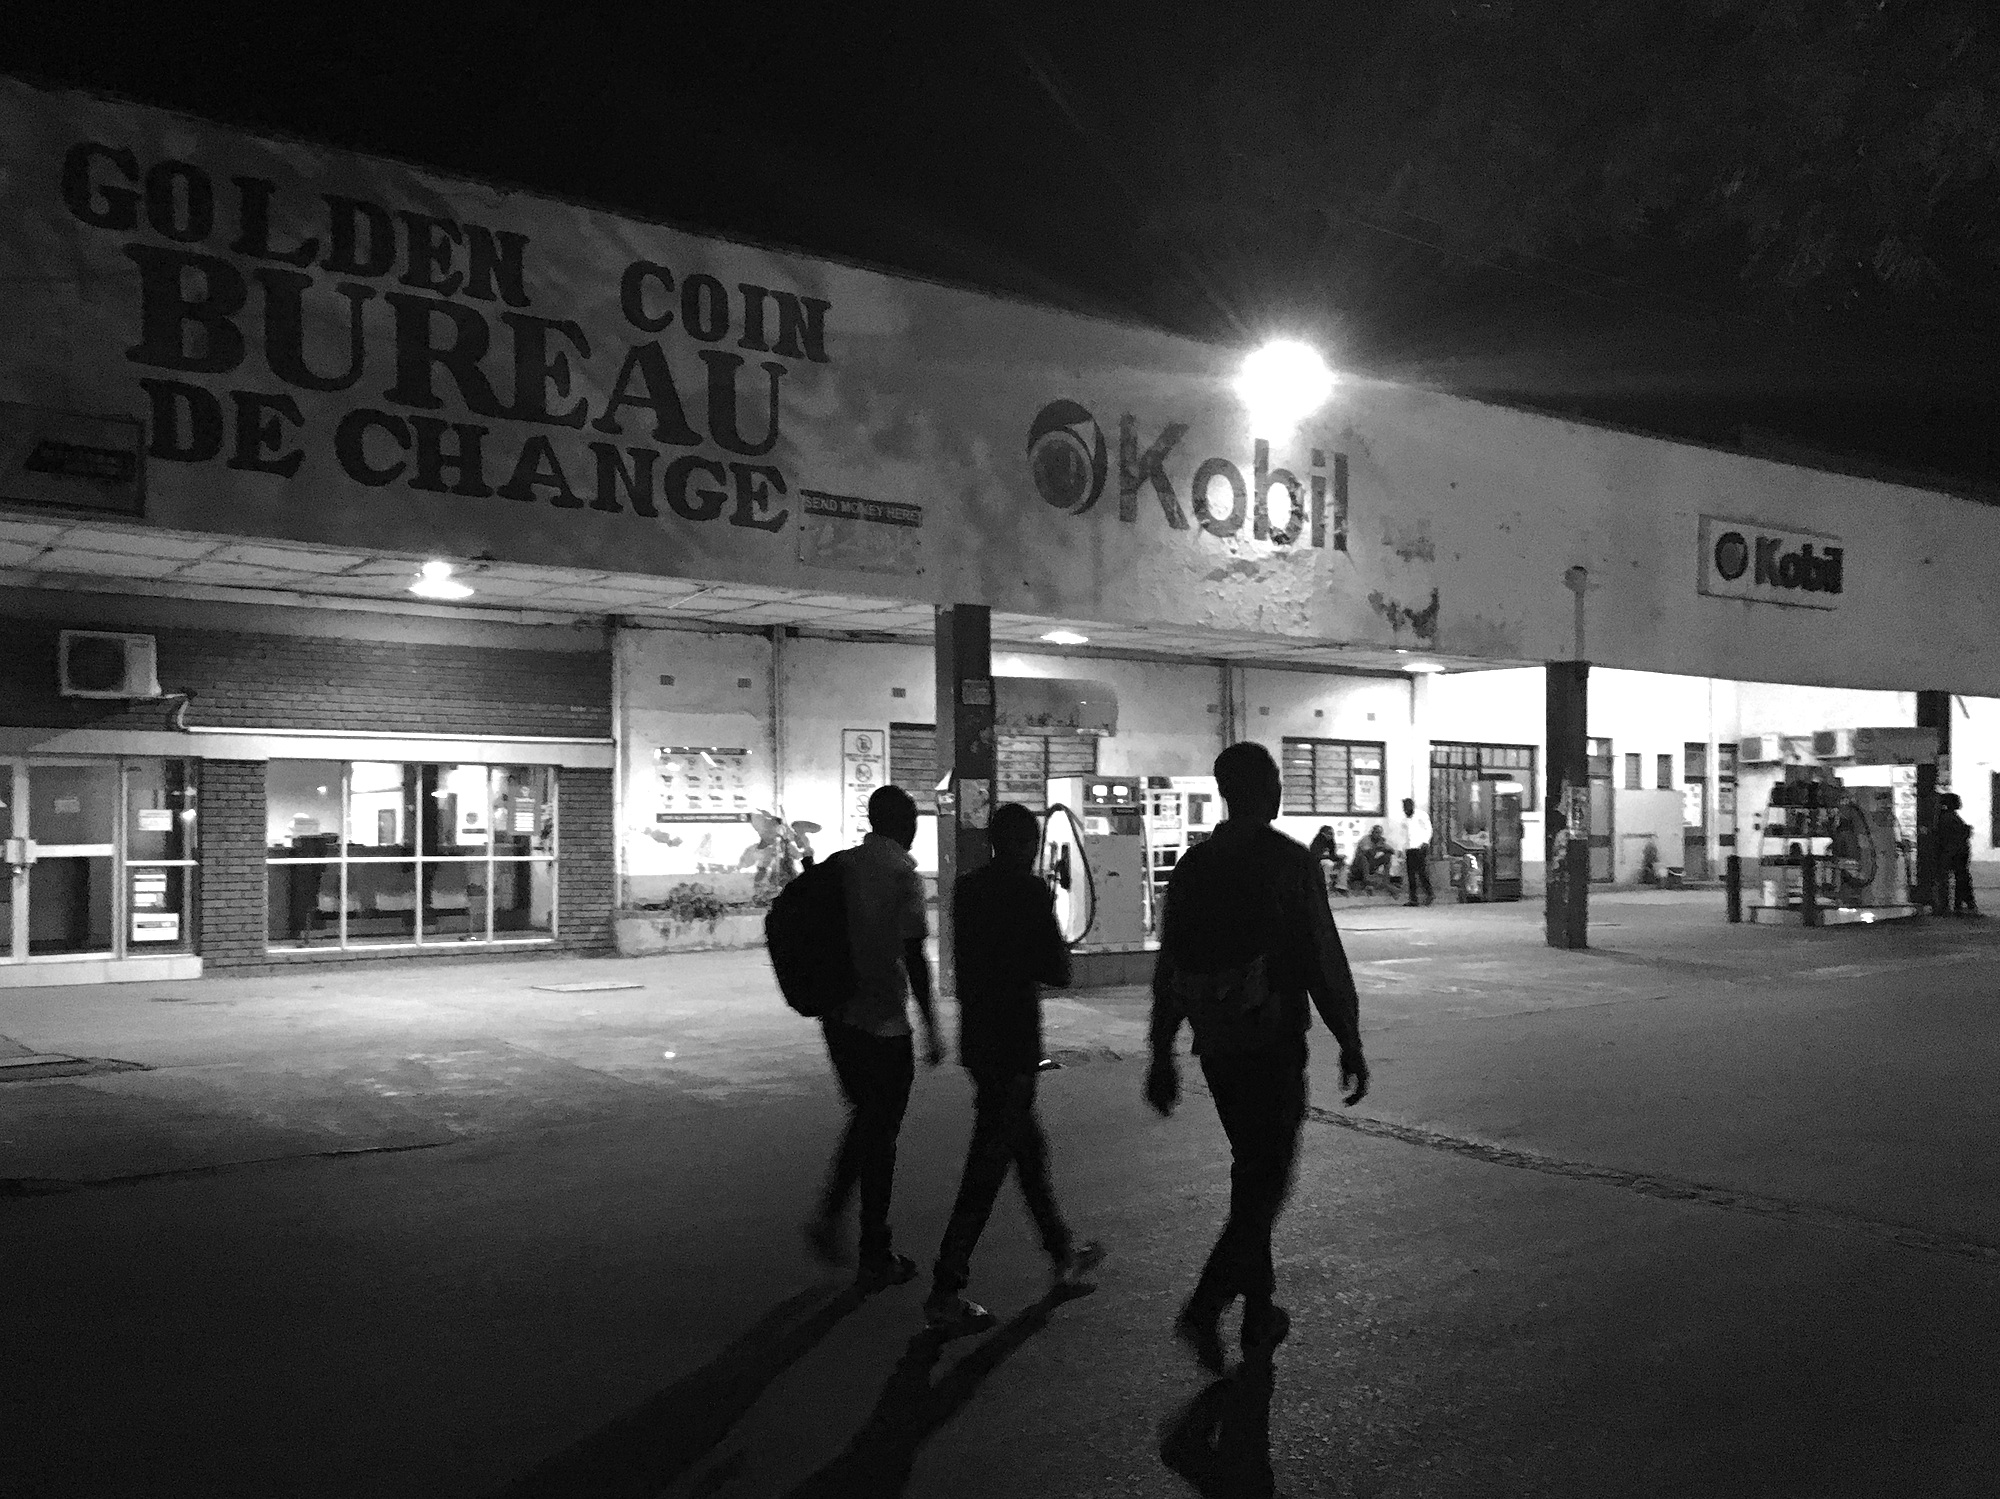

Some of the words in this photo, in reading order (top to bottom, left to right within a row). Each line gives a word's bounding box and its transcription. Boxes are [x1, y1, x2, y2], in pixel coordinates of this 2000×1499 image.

[61, 140, 532, 308] GOLDEN
[620, 258, 831, 364] COIN
[123, 243, 789, 456] BUREAU
[141, 376, 306, 478] DE
[335, 407, 789, 533] CHANGE
[804, 496, 838, 511] SEND
[841, 500, 881, 516] MONEY
[1118, 413, 1349, 552] Kobil
[1754, 535, 1844, 595] Kobil
